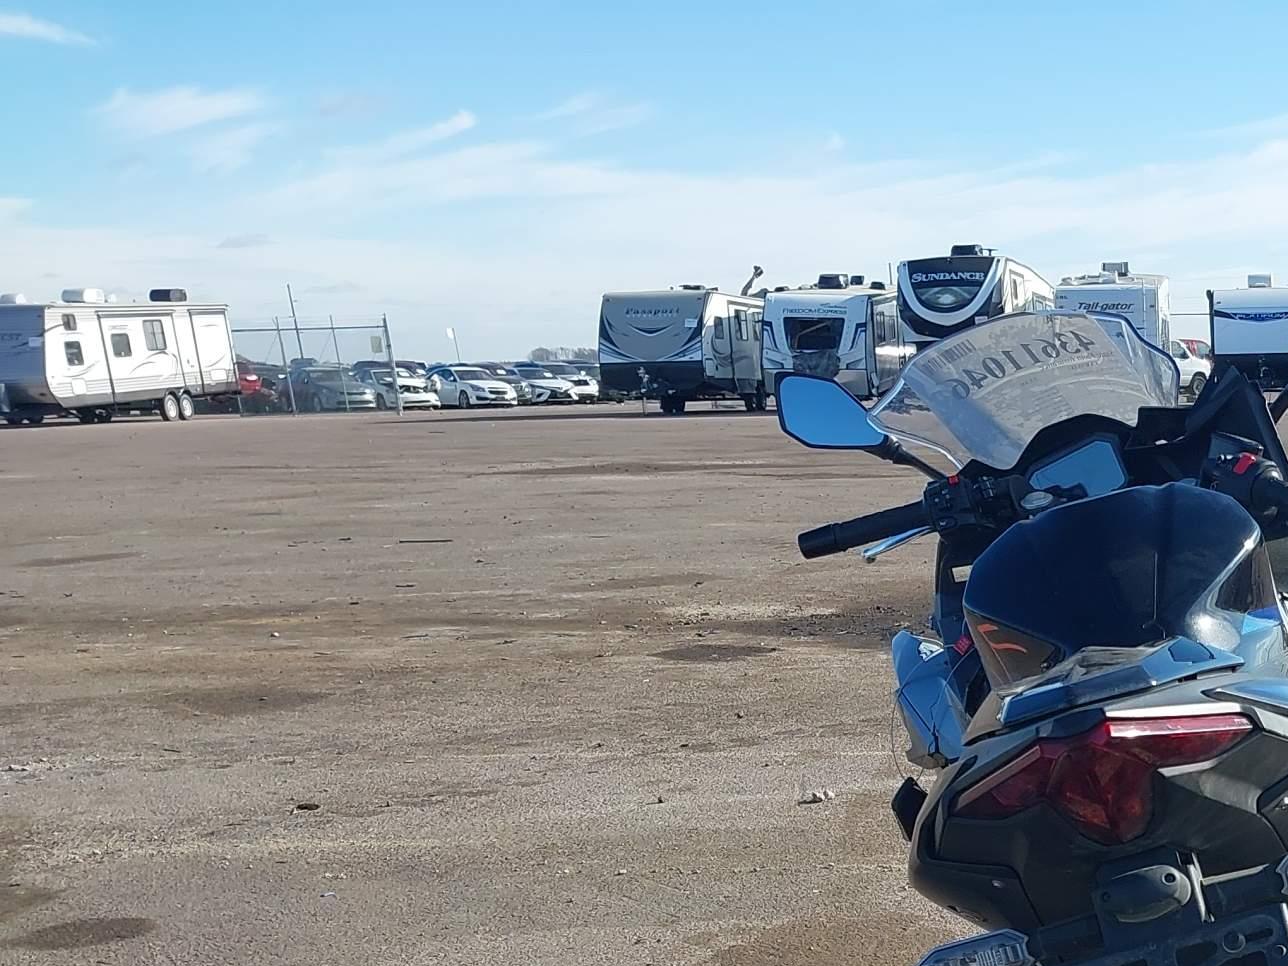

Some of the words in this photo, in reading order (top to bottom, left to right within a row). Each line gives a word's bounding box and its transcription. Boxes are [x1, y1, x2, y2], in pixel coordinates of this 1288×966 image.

[911, 272, 985, 283] SUNDANCE
[1078, 302, 1135, 311] Tail-gator
[624, 307, 681, 316] Passport
